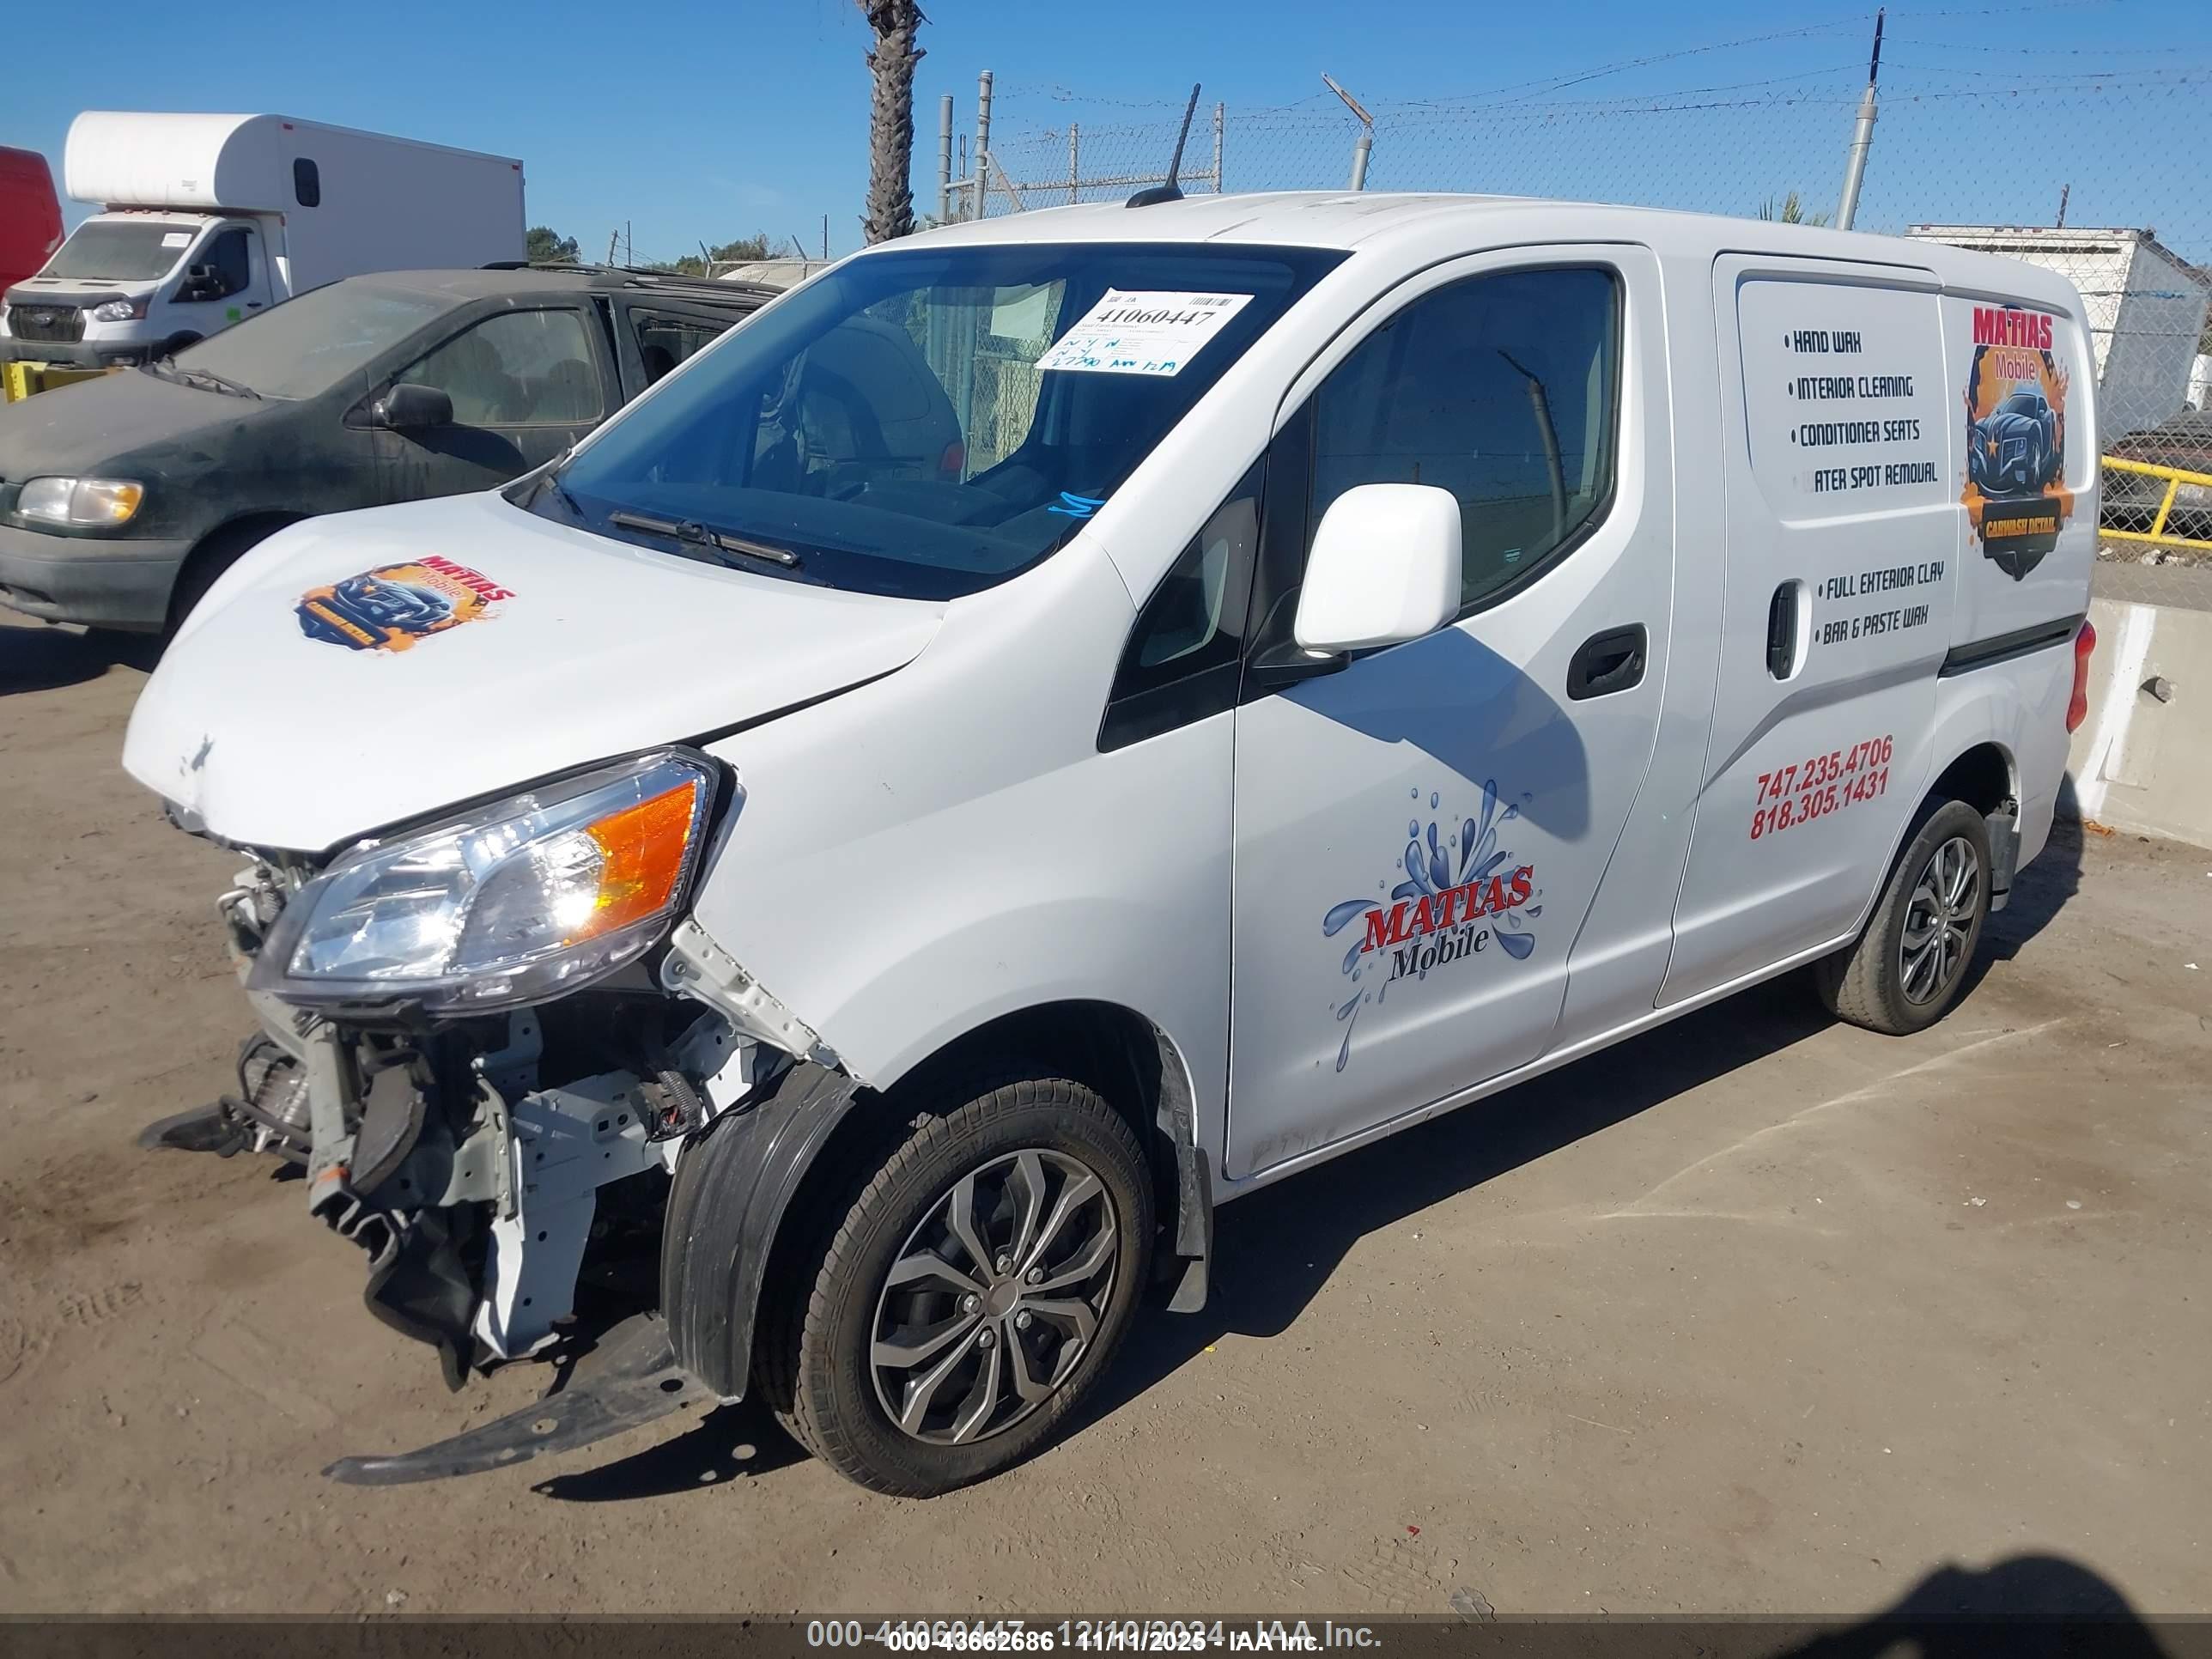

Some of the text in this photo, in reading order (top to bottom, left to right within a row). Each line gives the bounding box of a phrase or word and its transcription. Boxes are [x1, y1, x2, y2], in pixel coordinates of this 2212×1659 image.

[1097, 308, 1216, 325] 41060447
[1973, 307, 2053, 349] MATIAS
[1793, 330, 1863, 353] HAND WAX
[1995, 352, 2036, 380] Mobile
[1797, 375, 1913, 399] INTERIOR CLEANING
[1800, 419, 1920, 447] CONDITIONER SEATS
[1850, 465, 1881, 489] SPOT
[1885, 461, 1938, 485] REMOVAL
[417, 555, 517, 603] MATIAS
[418, 570, 465, 599] Mobile
[1826, 560, 1944, 599] FULL EXTERIOR CLAY
[1823, 604, 1929, 645] BAR & PASTE WAX
[1757, 734, 1893, 805] 747.235.4706
[1750, 766, 1889, 840] 818.305.1431
[1360, 865, 1534, 954] MATIAS
[1388, 925, 1489, 982] Mobile
